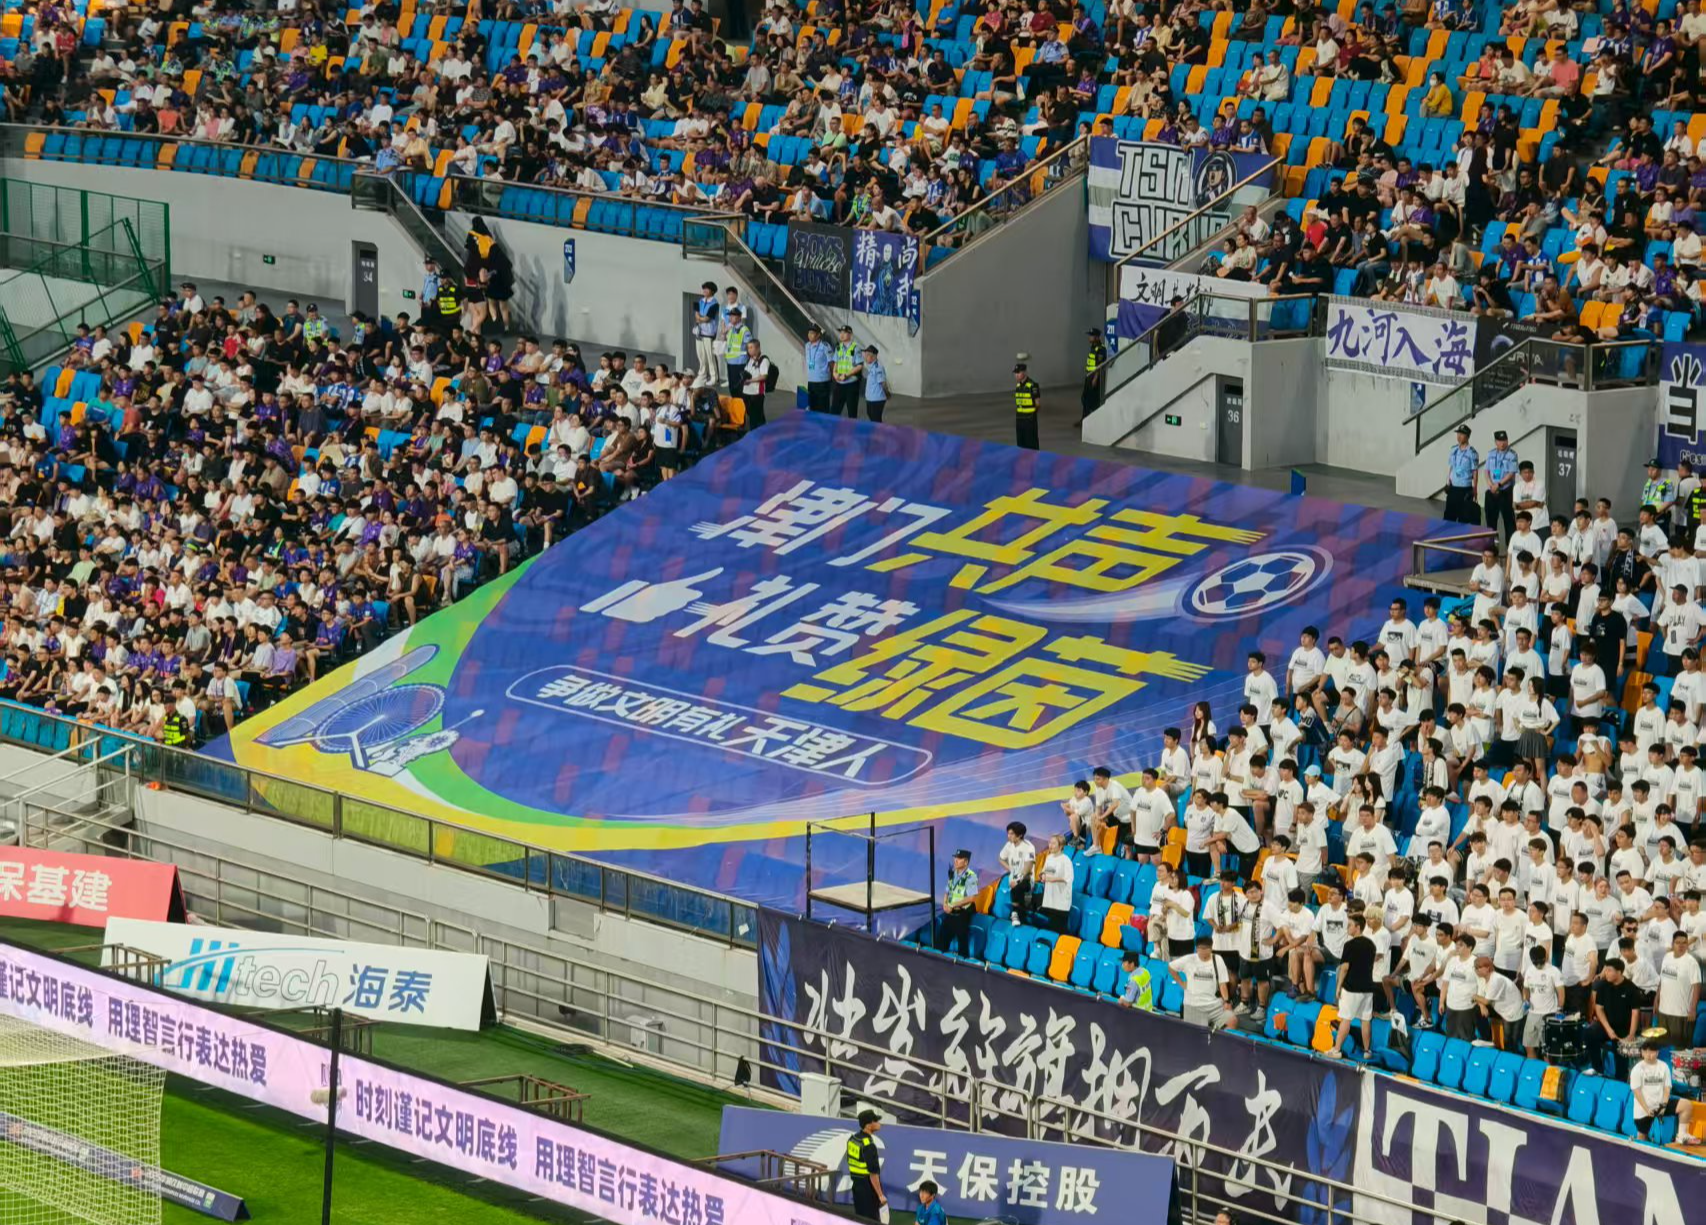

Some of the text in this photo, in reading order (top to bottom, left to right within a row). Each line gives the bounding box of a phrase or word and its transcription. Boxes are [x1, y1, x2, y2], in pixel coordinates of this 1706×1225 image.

[853, 231, 880, 313] 精神
[1327, 308, 1473, 376] 九河入海
[1227, 409, 1240, 424] 36
[1558, 462, 1572, 478] 37
[342, 963, 432, 1014] 海泰
[107, 995, 267, 1087] 用理智言行表达热爱
[355, 1079, 725, 1225] 时刻谨记文明底线 用理智言行表达热爱
[906, 1149, 1101, 1216] 天保控股
